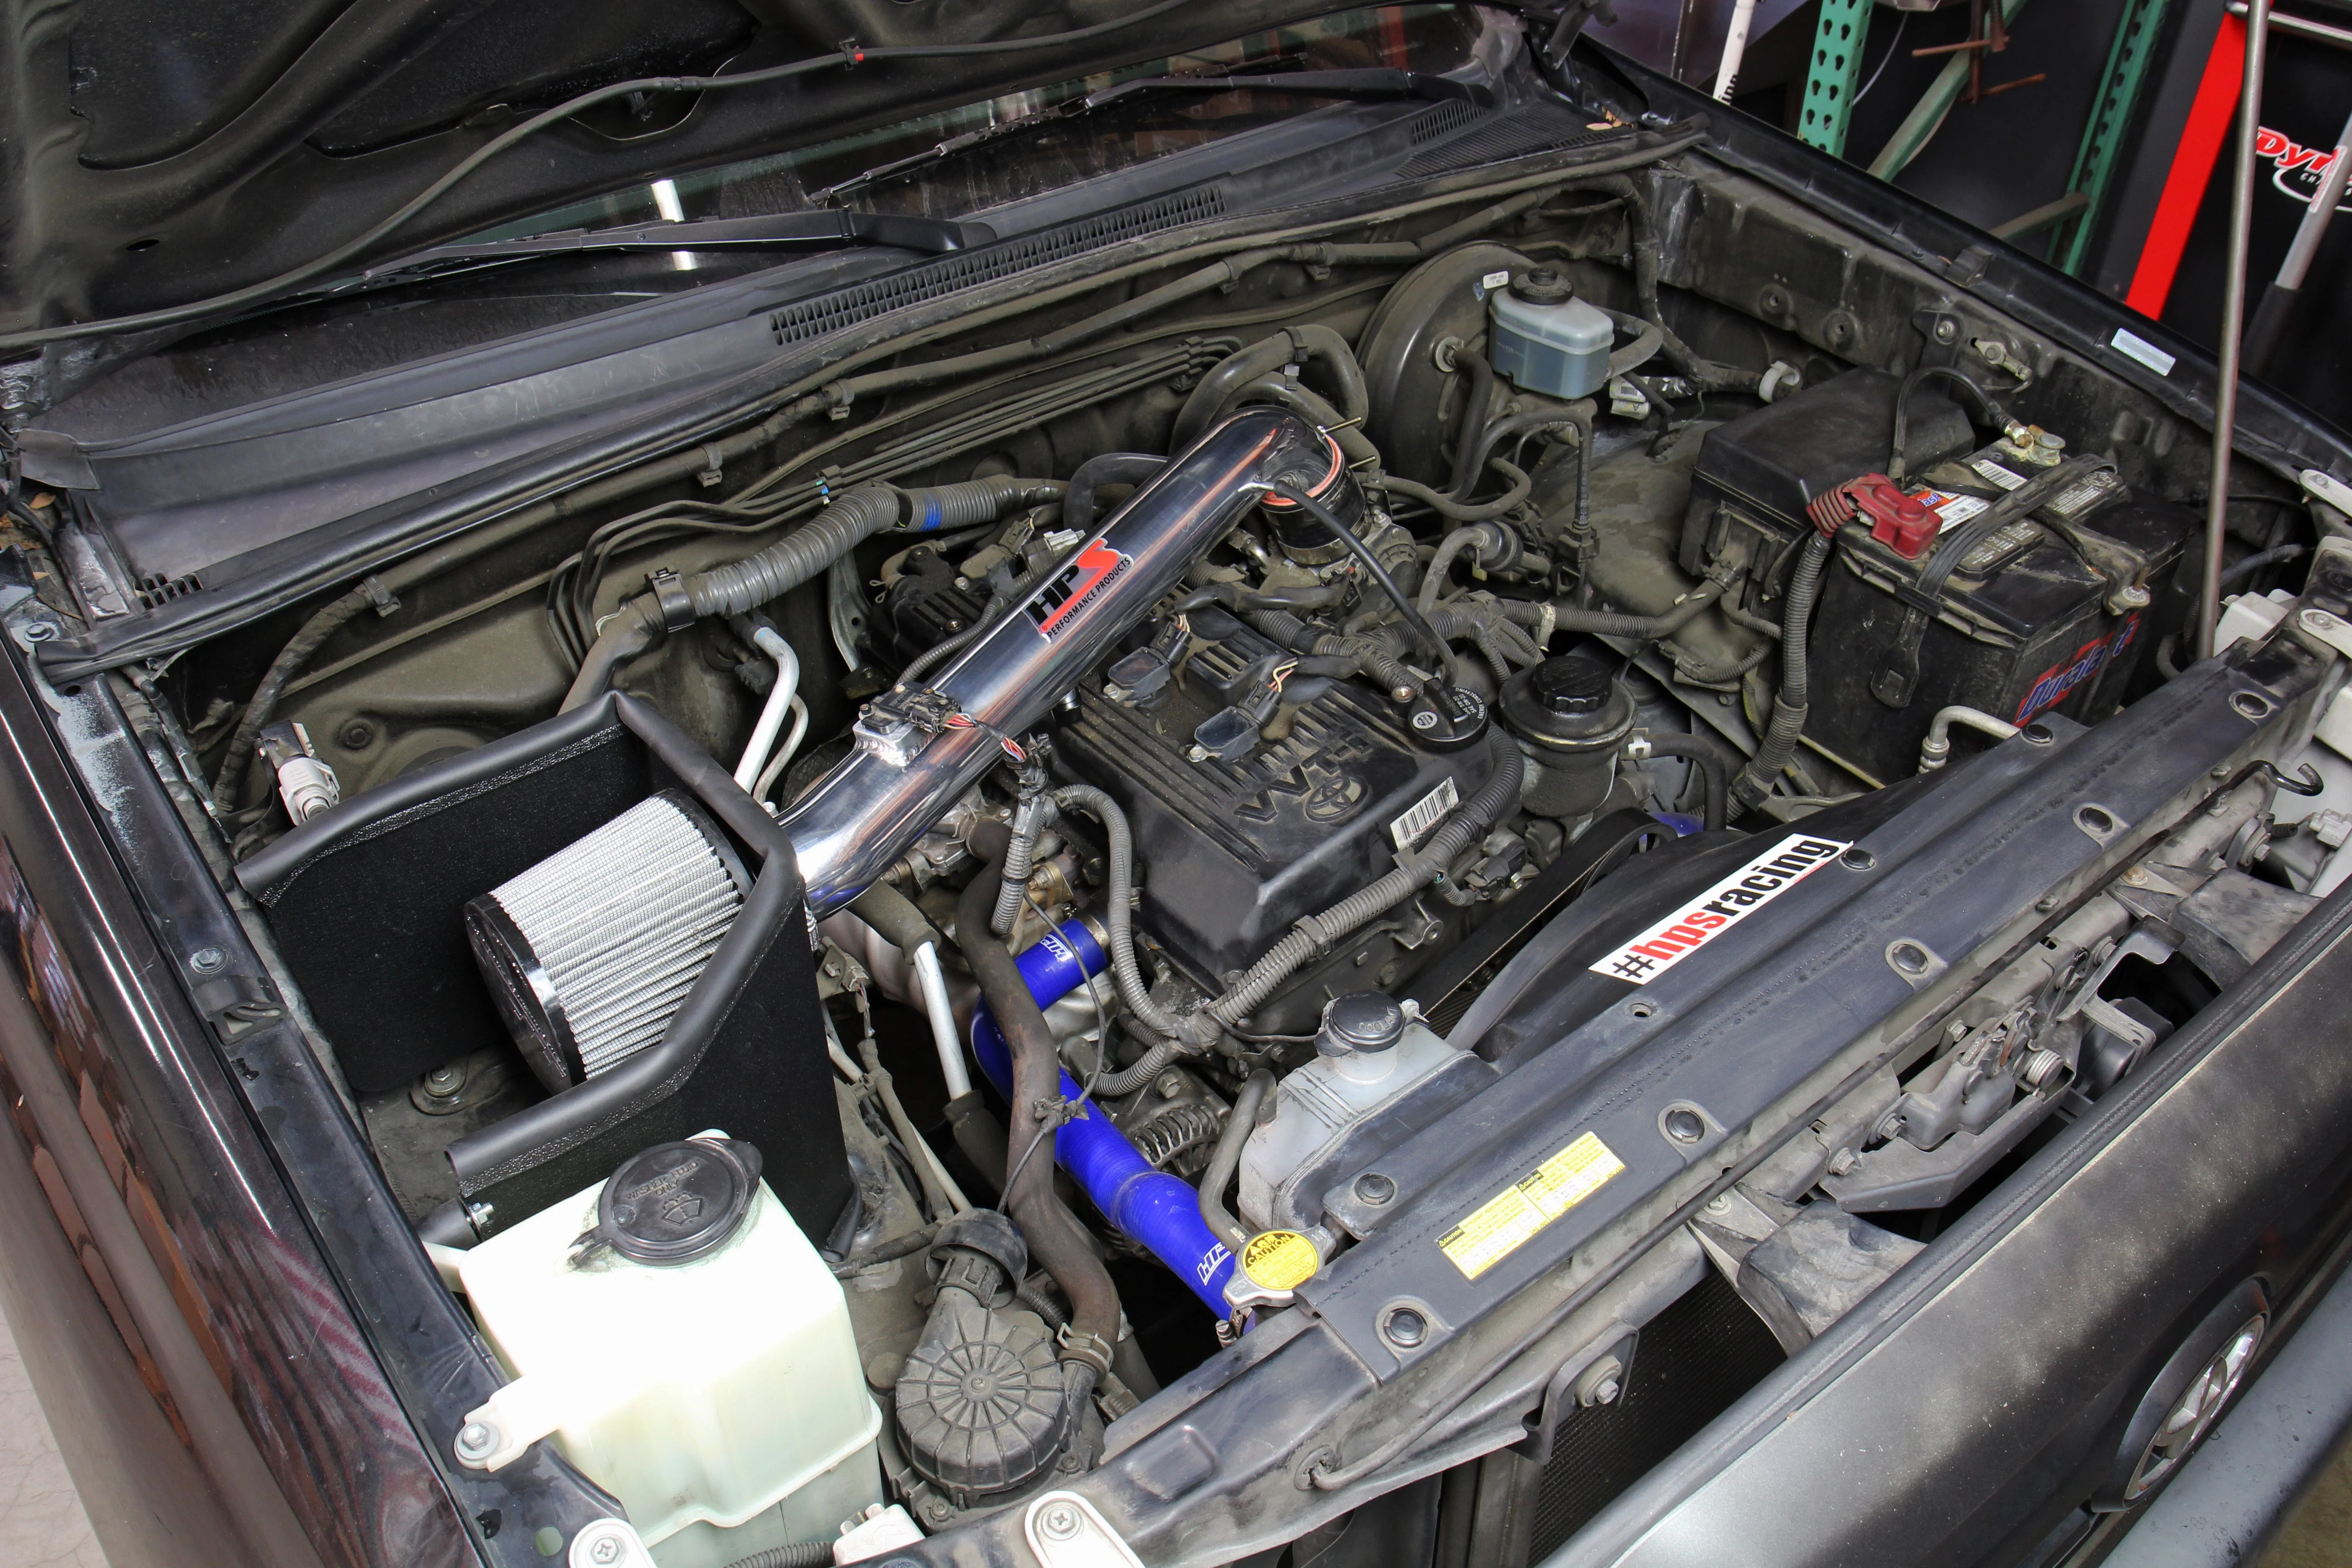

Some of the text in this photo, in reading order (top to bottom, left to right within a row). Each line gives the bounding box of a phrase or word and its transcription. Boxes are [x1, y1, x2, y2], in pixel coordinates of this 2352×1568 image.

[1026, 538, 1118, 631] HPS
[1048, 557, 1131, 639] PERFORMANCE PRODUCTS
[2016, 620, 2136, 723] Duralat
[1453, 696, 1465, 709] 5W-20
[1455, 687, 1485, 720] ENERGY CONSERVING
[1468, 703, 1477, 714] SAE
[1612, 839, 1840, 979] #hpsracing
[1358, 1006, 1399, 1034] COOLANT
[626, 1161, 699, 1200] WASHER FLUID
[655, 1179, 679, 1196] ONLY
[1524, 1173, 1542, 1187] CAUTON
[1248, 1234, 1291, 1265] CAUTION
[1444, 1229, 1462, 1243] CAUTION
[1278, 1262, 1312, 1286] COOLANT
